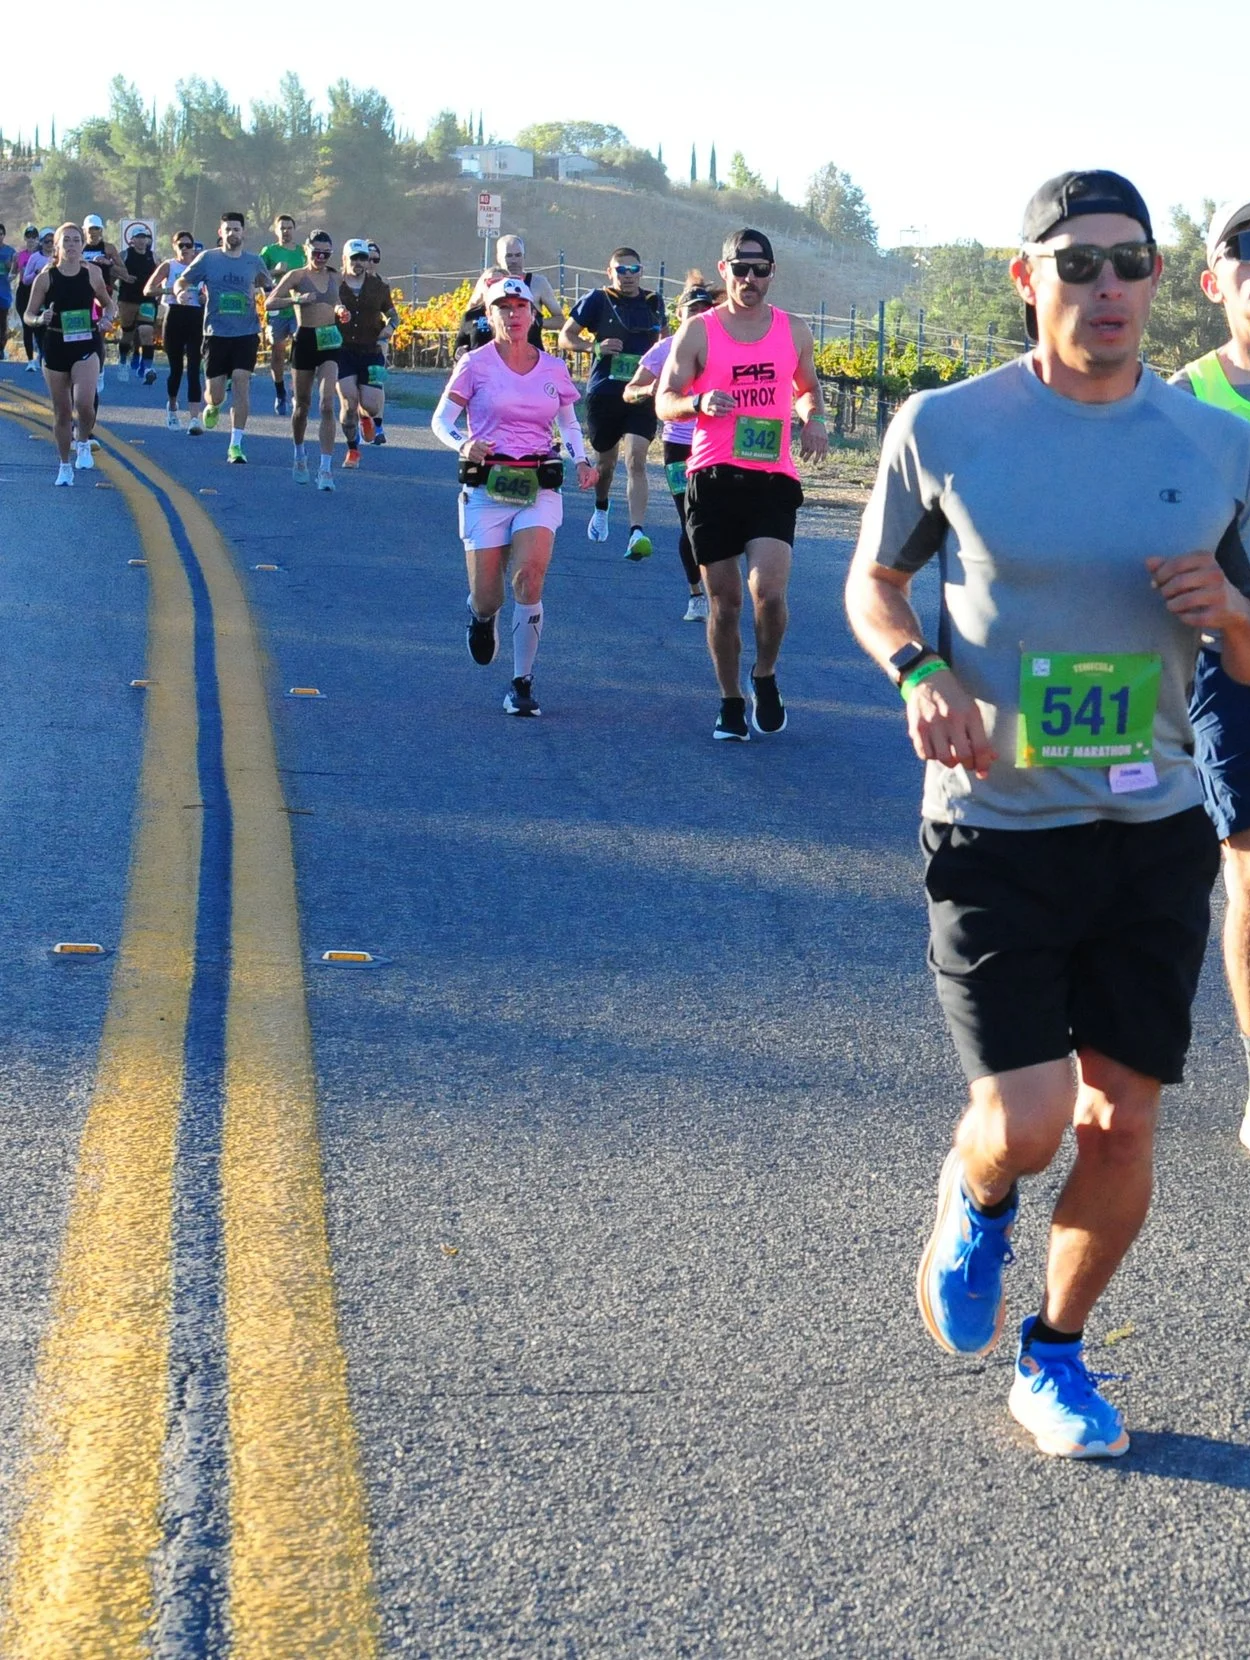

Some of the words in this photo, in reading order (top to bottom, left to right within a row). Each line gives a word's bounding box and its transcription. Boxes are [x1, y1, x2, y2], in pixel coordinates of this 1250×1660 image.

[480, 195, 490, 203] NO
[480, 205, 501, 213] PARKING
[479, 228, 499, 237] BEGIN
[732, 363, 775, 382] F45
[742, 427, 776, 450] 342
[495, 475, 531, 497] 645
[1072, 662, 1114, 674] TEMECULA
[1041, 685, 1130, 737] 541
[1042, 745, 1071, 758] HALF
[1072, 743, 1133, 758] MARATHON
